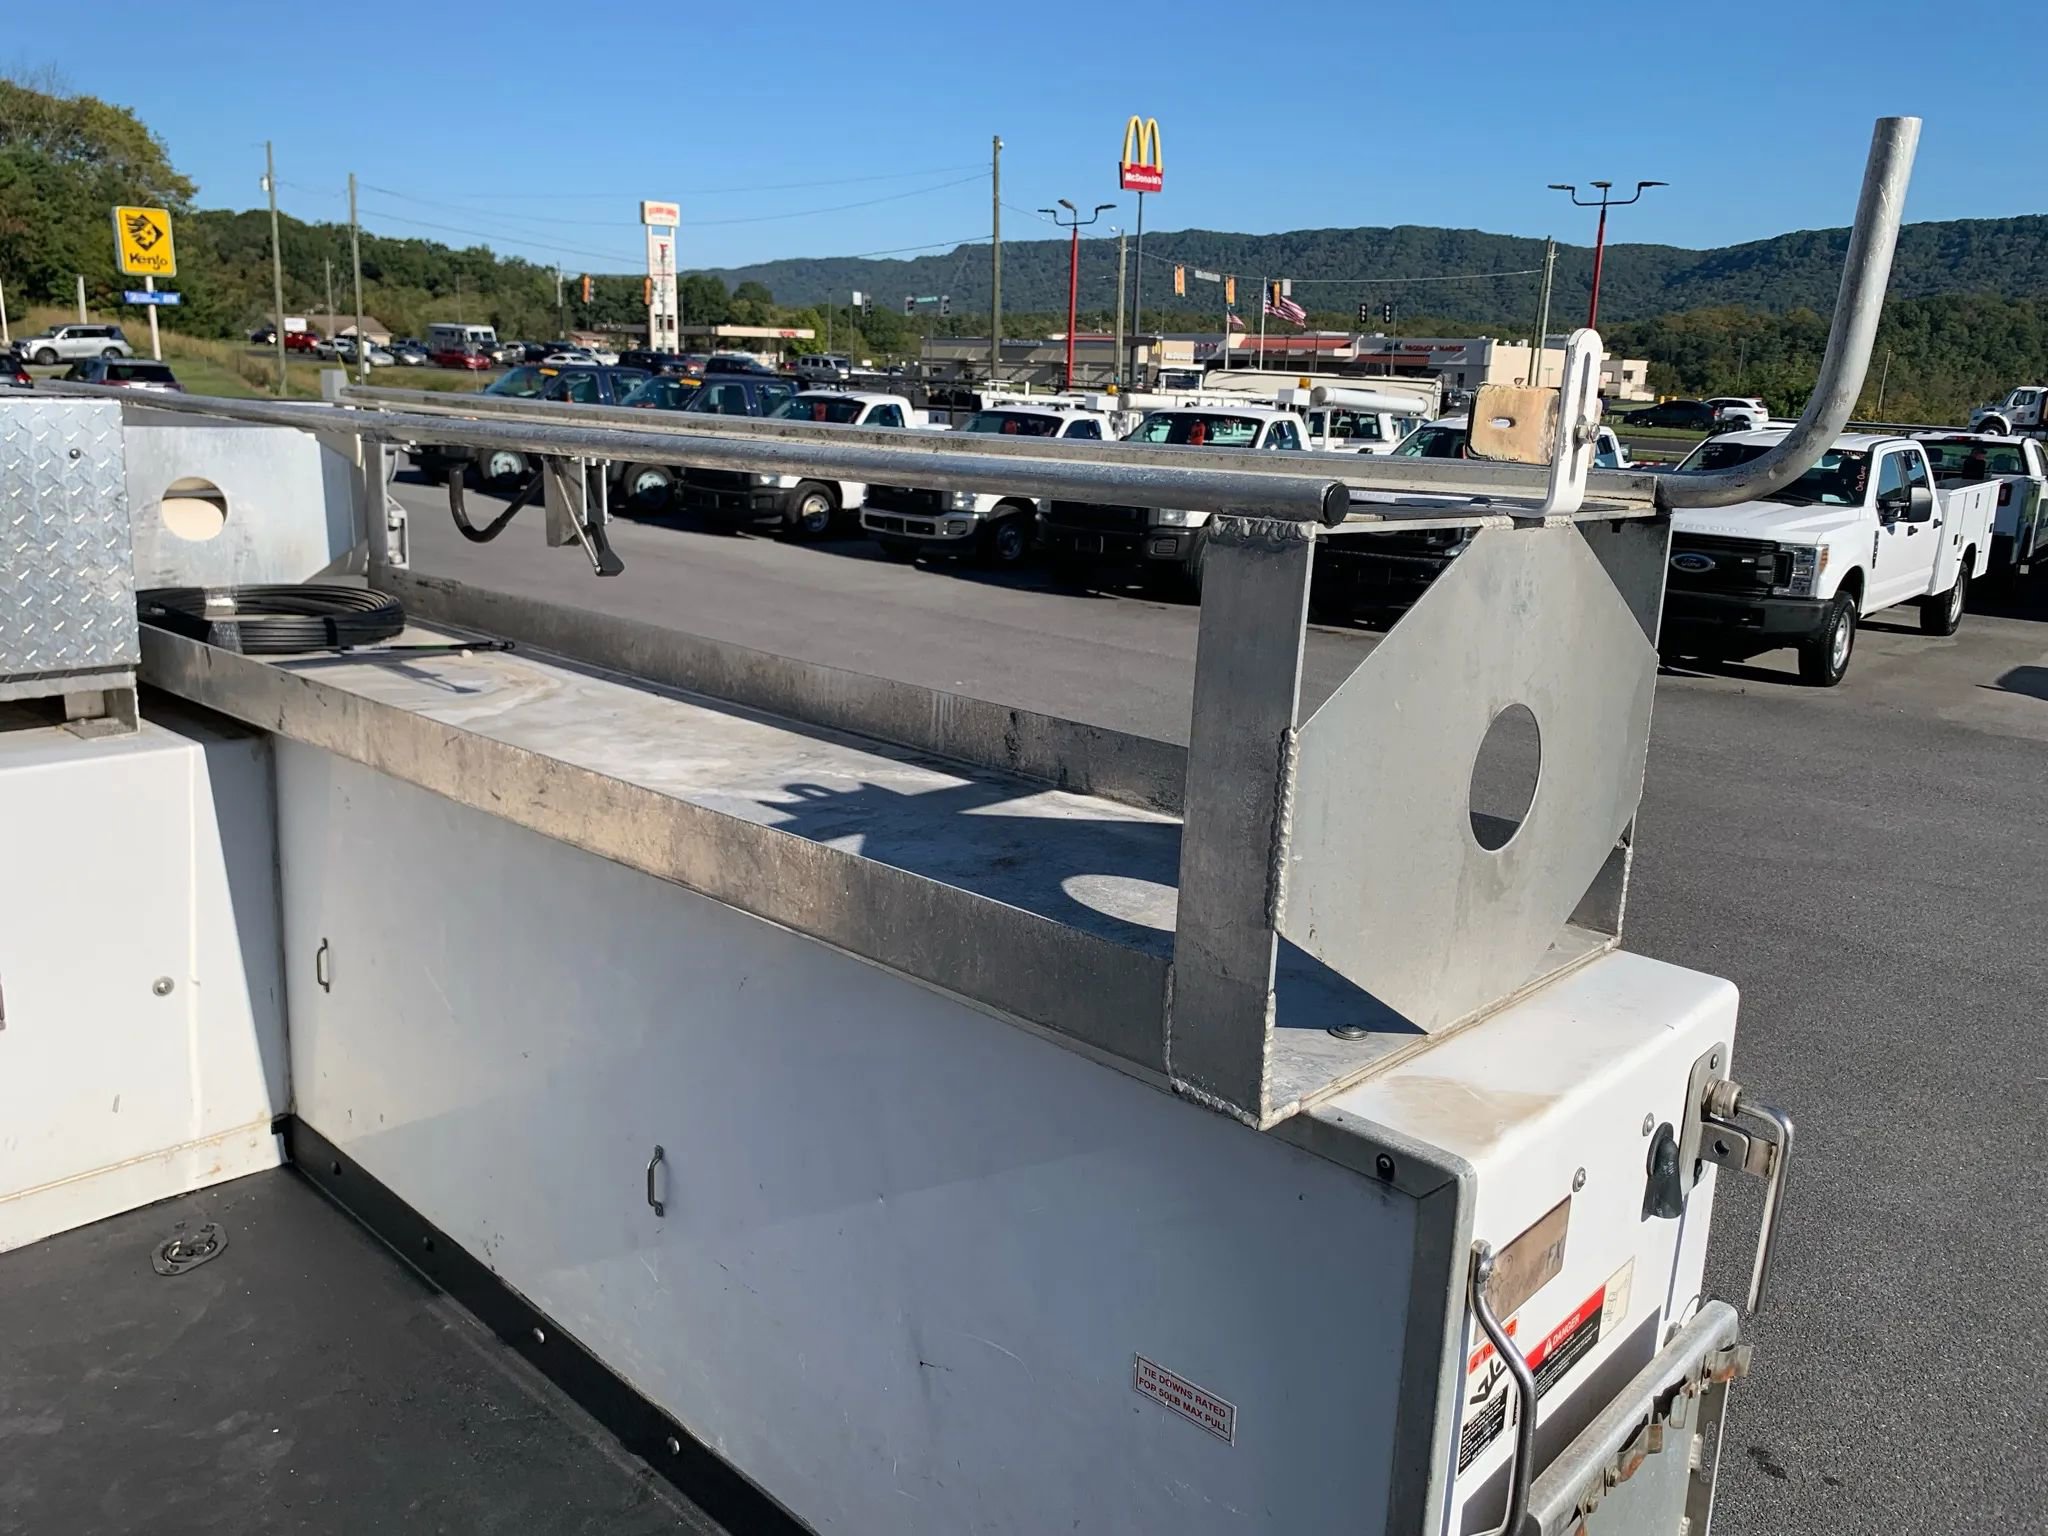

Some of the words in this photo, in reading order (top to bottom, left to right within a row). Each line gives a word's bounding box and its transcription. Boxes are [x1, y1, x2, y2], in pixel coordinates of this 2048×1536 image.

[1125, 172, 1162, 185] McDonald's
[129, 252, 168, 270] Kenjo
[1552, 1313, 1580, 1346] DANGER
[1139, 1377, 1157, 1392] FOR
[1159, 1388, 1181, 1406] 50LB
[1183, 1402, 1203, 1419] MAX
[1205, 1414, 1229, 1434] PULL
[1144, 1366, 1157, 1380] TIE
[1159, 1374, 1193, 1400] DOWNS
[1195, 1395, 1226, 1418] RATED
